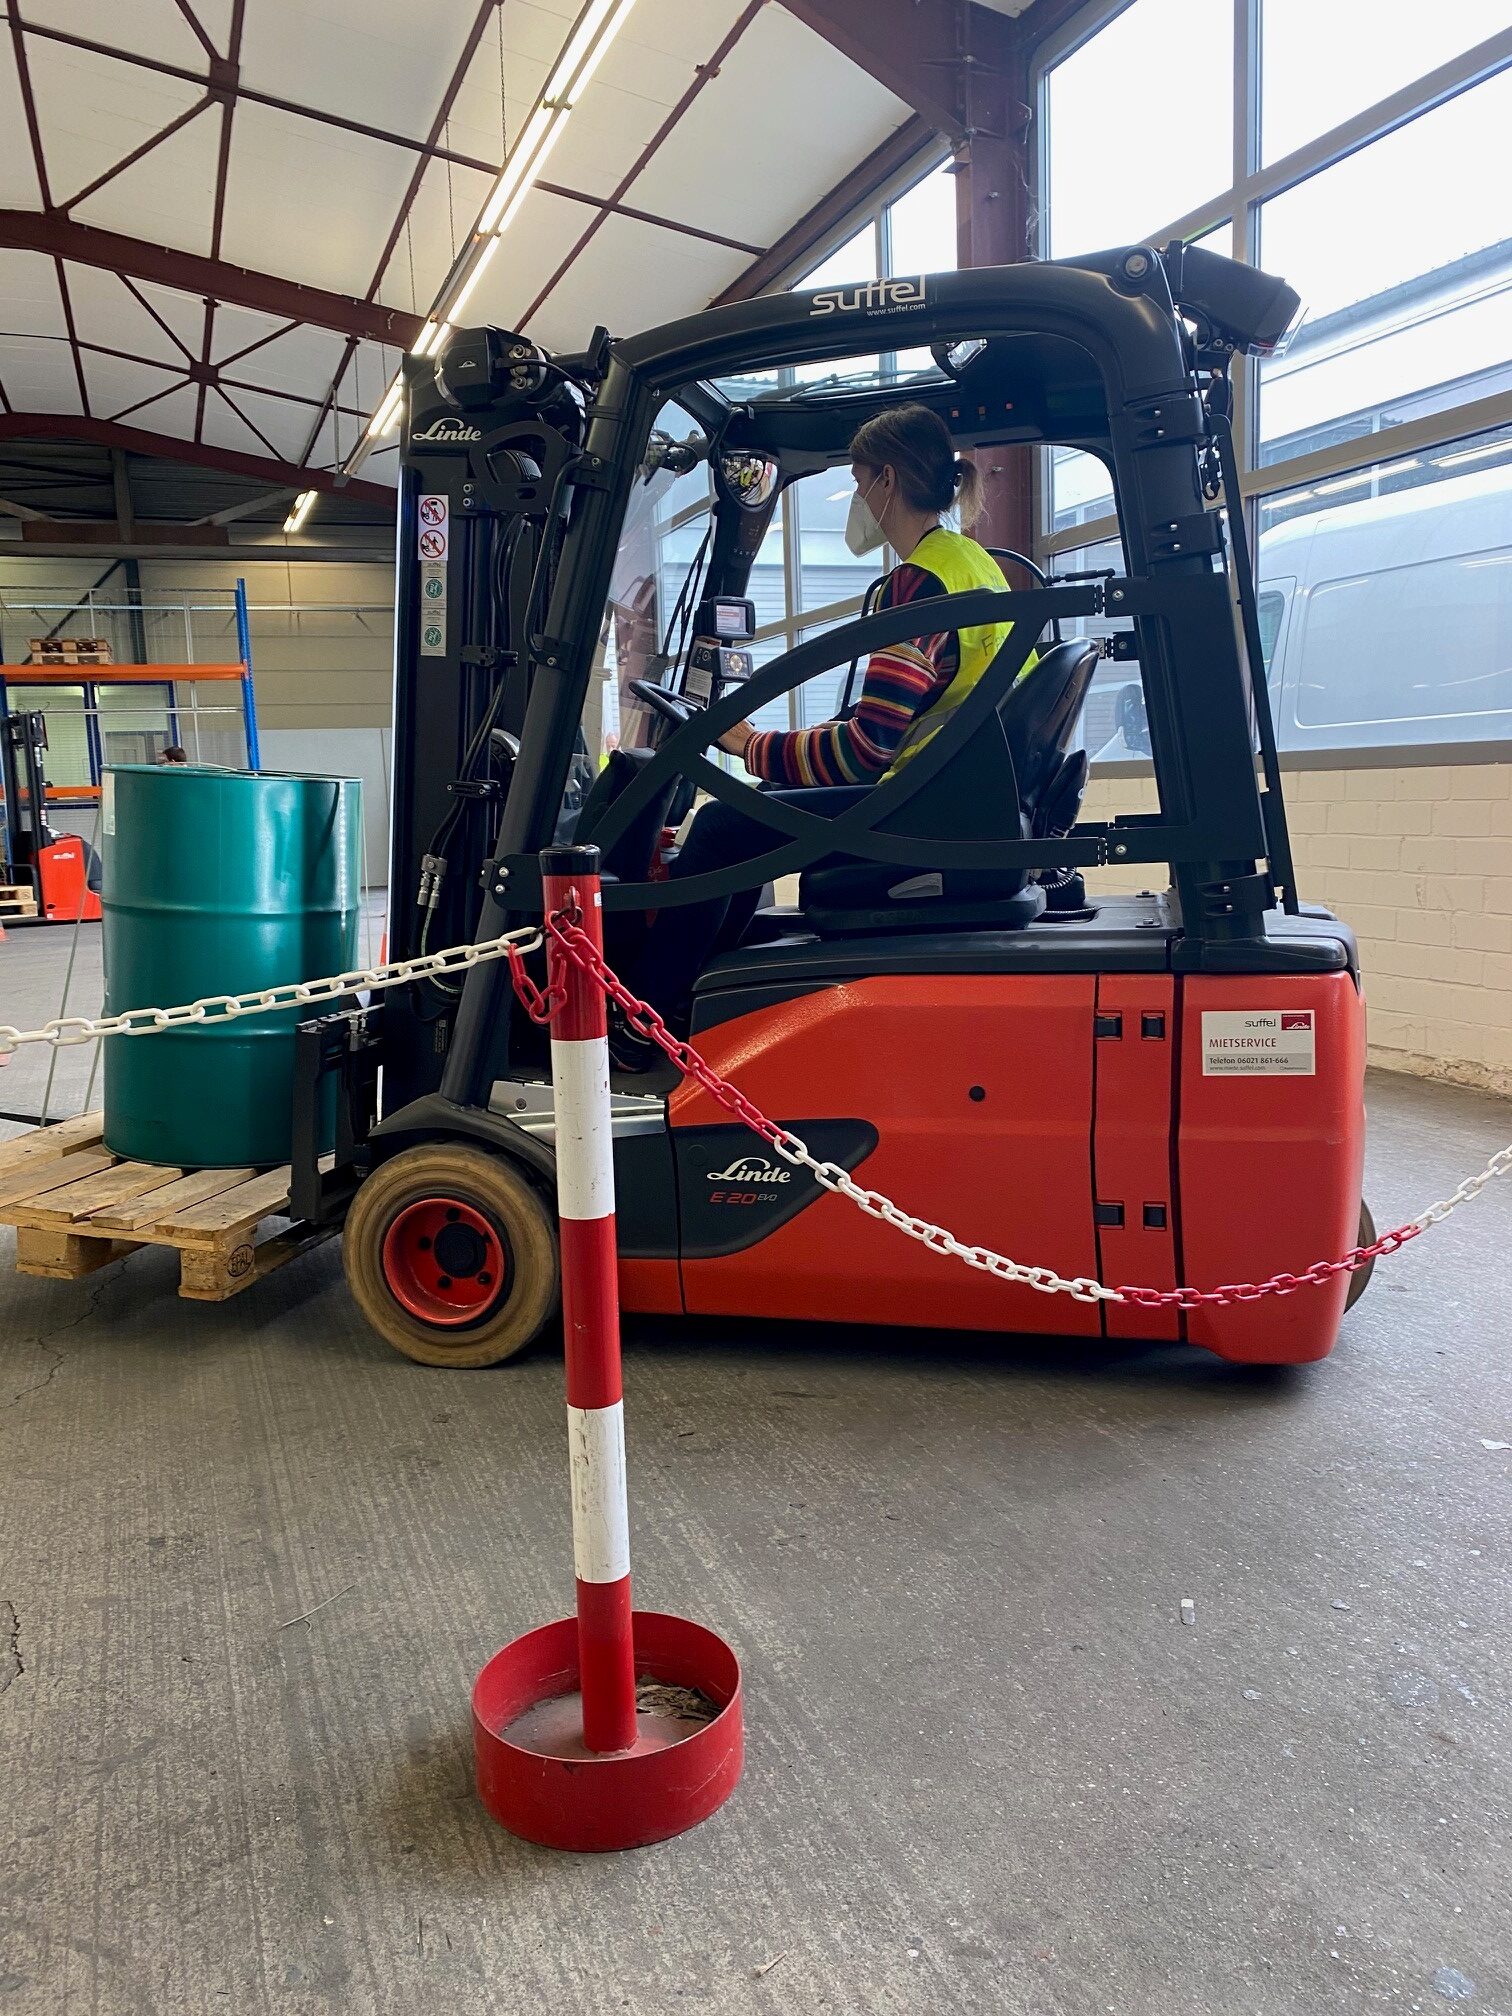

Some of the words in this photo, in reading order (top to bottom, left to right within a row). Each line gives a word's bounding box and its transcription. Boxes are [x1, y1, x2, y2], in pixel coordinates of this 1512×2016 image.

[810, 274, 926, 316] suffel
[866, 303, 926, 317] www.suffel.com
[412, 417, 482, 441] Linde
[1244, 1018, 1277, 1028] suffel
[1209, 1037, 1278, 1048] MIETSERVICE
[1209, 1056, 1236, 1065] Telefon
[1237, 1056, 1259, 1065] 06021
[1260, 1056, 1289, 1065] 861-666
[706, 1157, 791, 1184] Linde
